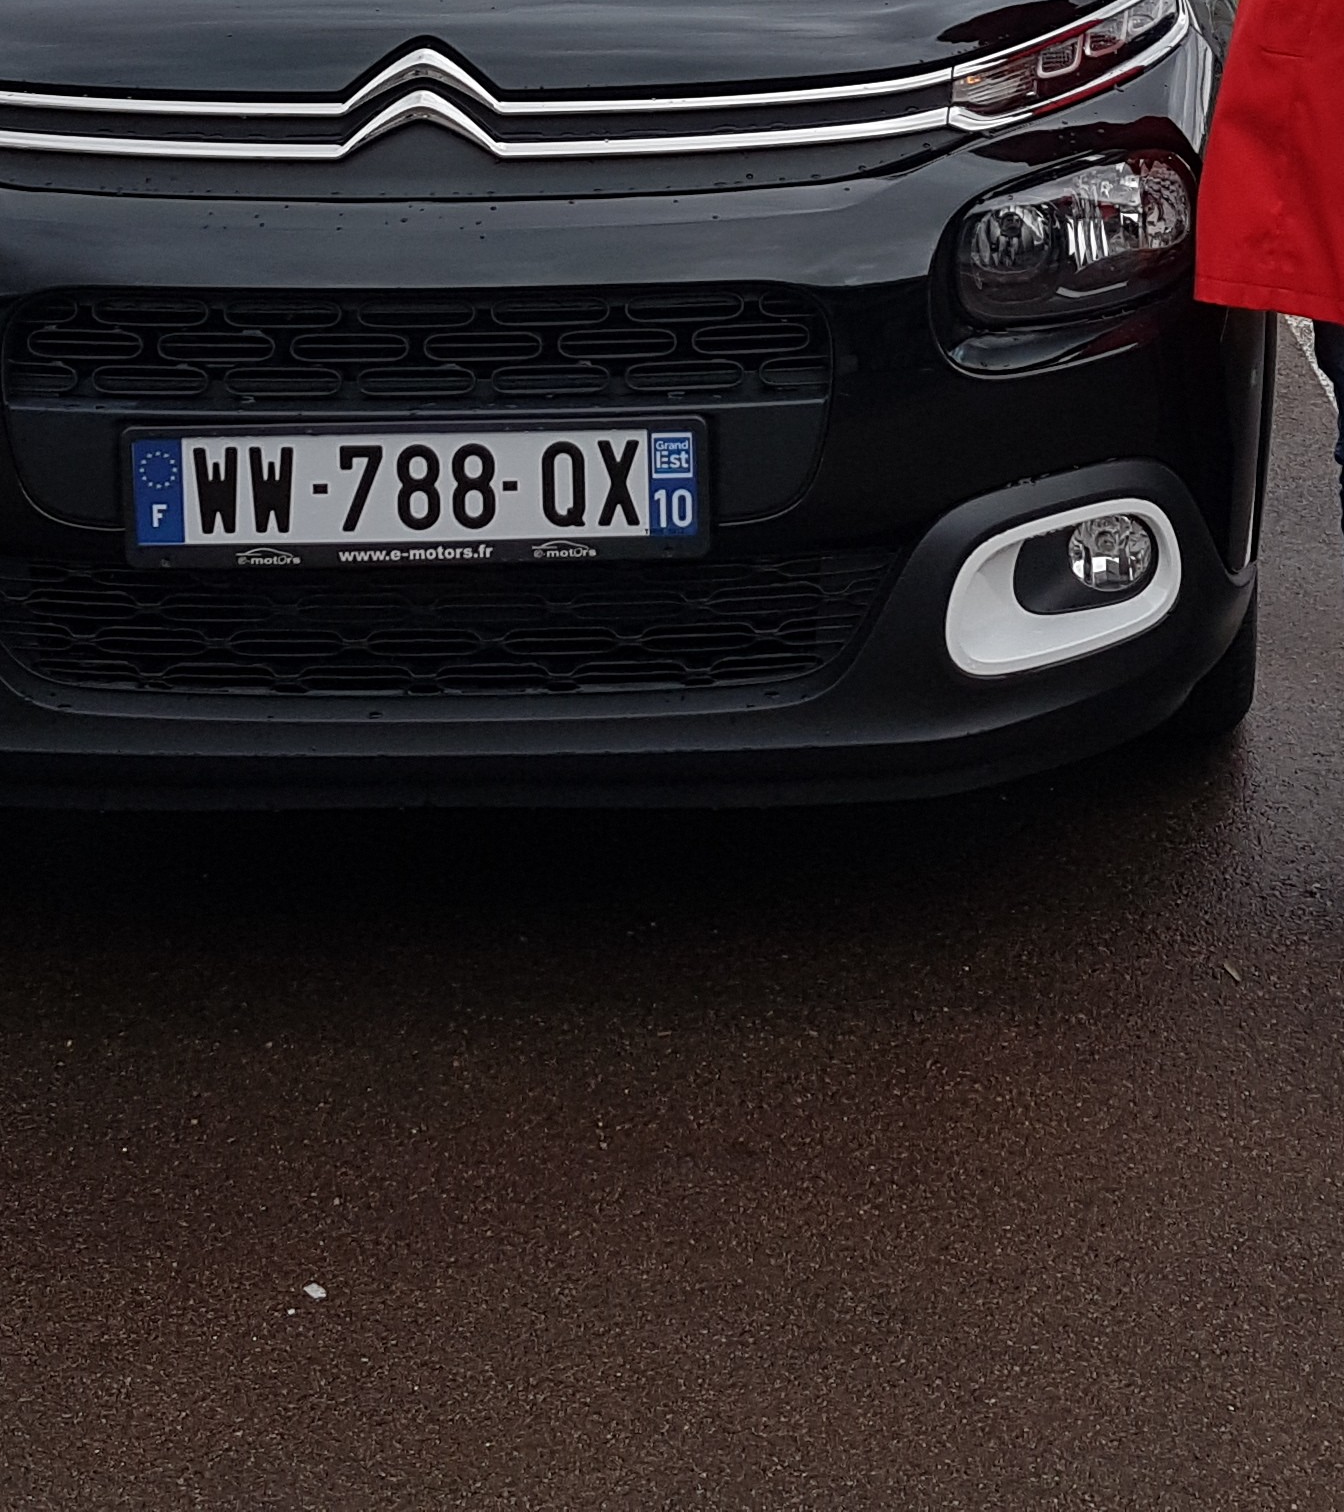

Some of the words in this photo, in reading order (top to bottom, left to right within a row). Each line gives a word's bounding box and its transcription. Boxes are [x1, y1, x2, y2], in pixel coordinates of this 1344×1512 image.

[656, 440, 689, 450] Grand
[656, 451, 689, 469] Est
[192, 440, 640, 534] WW-788-QX
[152, 504, 167, 528] F
[654, 488, 693, 528] 10
[338, 544, 494, 562] www.e-motors.fr
